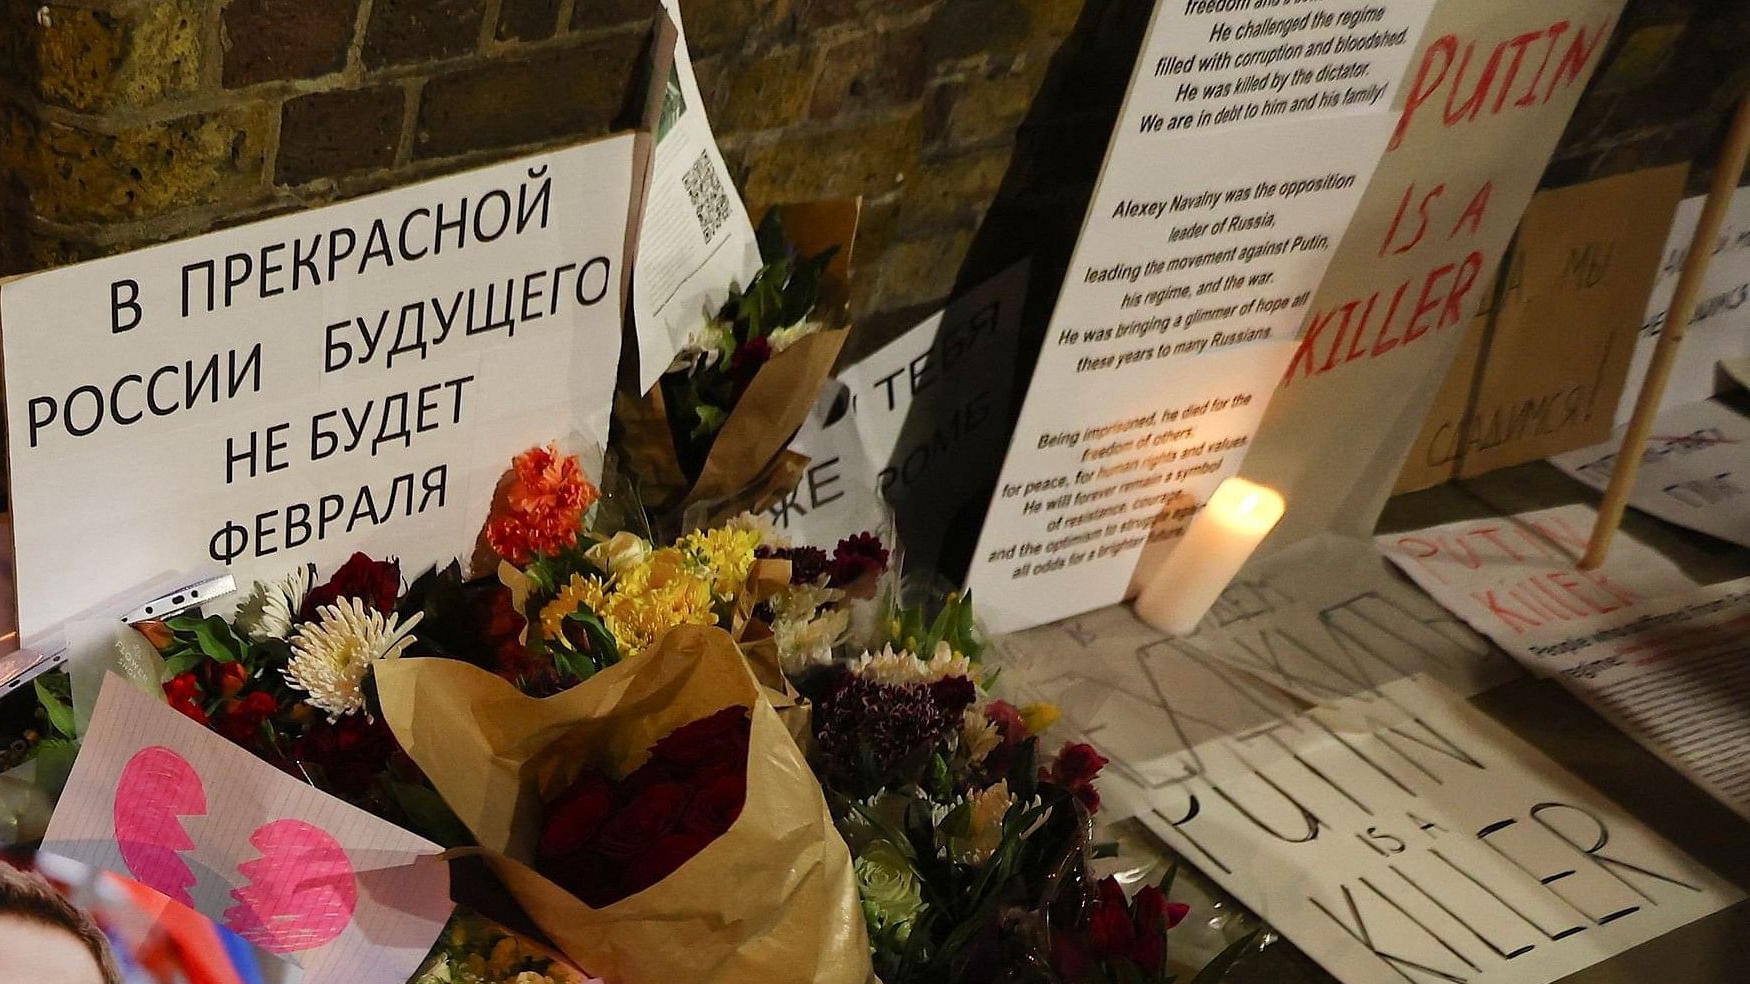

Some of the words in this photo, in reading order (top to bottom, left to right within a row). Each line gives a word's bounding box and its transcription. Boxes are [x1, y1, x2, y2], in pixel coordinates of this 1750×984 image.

[1209, 23, 1231, 42] He
[1235, 12, 1311, 40] challenged
[1311, 10, 1332, 26] the
[1336, 6, 1386, 27] regime
[1154, 56, 1192, 77] filled
[1199, 51, 1232, 72] with
[1234, 44, 1301, 67] corruption
[1304, 40, 1330, 56] and
[1176, 84, 1198, 102] He
[1202, 81, 1231, 98] was
[1234, 70, 1268, 93] killed
[1271, 69, 1288, 92] by
[1290, 66, 1311, 84] the
[1385, 19, 1609, 152] PUTIN
[1140, 116, 1162, 134] We
[1167, 114, 1192, 130] are
[1197, 110, 1210, 127] in
[1214, 104, 1241, 125] debt
[1244, 102, 1258, 120] to
[1261, 99, 1286, 117] him
[1290, 96, 1314, 112] and
[1318, 91, 1340, 108] his
[1112, 200, 1168, 219] Alexey
[1169, 191, 1222, 213] Navalny
[1225, 183, 1251, 202] was
[1253, 180, 1276, 199] the
[1279, 173, 1355, 197] opposition
[1380, 183, 1446, 258] IS
[1448, 180, 1493, 241] A
[111, 278, 143, 334] В
[179, 164, 552, 319] ПРЕКРАСНОЙ
[1168, 225, 1208, 242] leader
[1211, 218, 1228, 236] of
[1084, 260, 1141, 284] leading
[1144, 257, 1165, 277] the
[1166, 249, 1237, 274] movement
[1238, 239, 1289, 261] against
[1121, 293, 1141, 310] his
[1196, 277, 1222, 296] and
[1223, 273, 1245, 290] the
[1058, 329, 1079, 346] He
[1084, 328, 1112, 344] was
[1115, 315, 1170, 340] bringing
[1173, 315, 1182, 328] a
[1184, 303, 1235, 327] glimmer
[1238, 298, 1254, 317] of
[1255, 290, 1289, 314] hope
[1290, 290, 1310, 307] all
[1283, 250, 1483, 388] KILLER
[28, 341, 264, 448] РОССИИ
[324, 255, 612, 375] БУДУЩЕГО
[1076, 355, 1115, 373] these
[1118, 347, 1154, 368] years
[1157, 344, 1171, 360] to
[1173, 337, 1207, 357] many
[225, 422, 290, 484] НЕ
[309, 375, 476, 462] БУДЕТ
[1037, 431, 1080, 449] Being
[1161, 406, 1179, 422] he
[1181, 402, 1209, 420] died
[1211, 398, 1229, 414] for
[1232, 393, 1252, 409] the
[1001, 483, 1021, 499] for
[1075, 470, 1095, 485] for
[1179, 443, 1205, 460] and
[1081, 442, 1133, 462] freedom
[1136, 434, 1152, 450] of
[208, 464, 449, 567] ФЕВРАЛЯ
[1023, 501, 1043, 516] He
[1046, 493, 1071, 510] will
[1074, 484, 1117, 503] forever
[1047, 518, 1063, 533] of
[988, 545, 1015, 563] and
[1020, 541, 1043, 556] the
[1012, 563, 1029, 579] all
[1032, 559, 1065, 576] odds
[1068, 552, 1086, 566] for
[1396, 516, 1592, 586] PUTIN
[1153, 717, 1486, 876] PUTIN
[1356, 825, 1406, 857] IS
[1406, 811, 1450, 835] A
